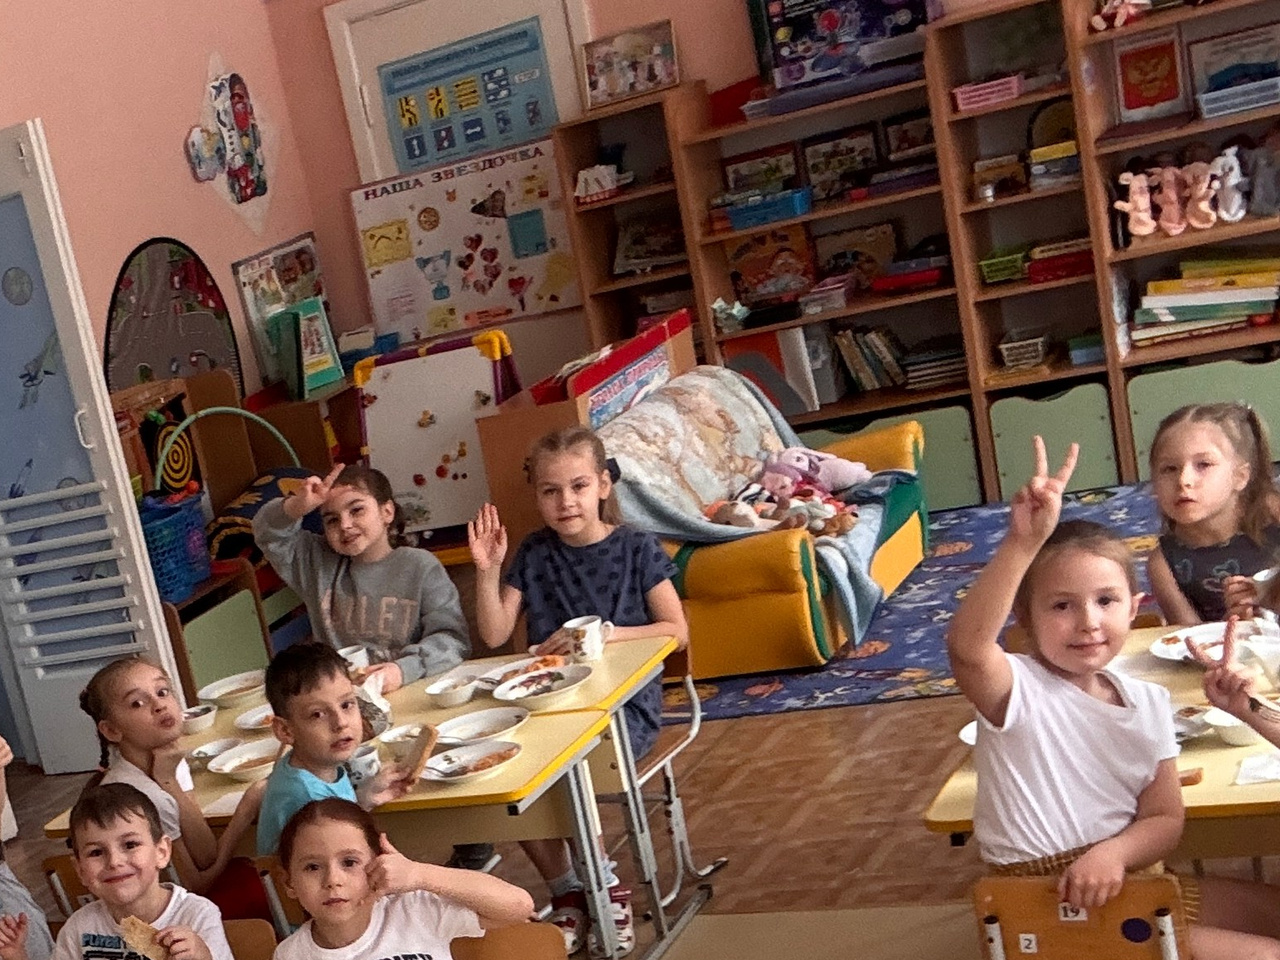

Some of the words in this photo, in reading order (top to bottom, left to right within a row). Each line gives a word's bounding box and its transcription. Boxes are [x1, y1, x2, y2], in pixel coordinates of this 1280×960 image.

[364, 178, 424, 200] НАША
[431, 146, 546, 183] ЗВЕЗДОЧКА
[1023, 937, 1033, 950] 2
